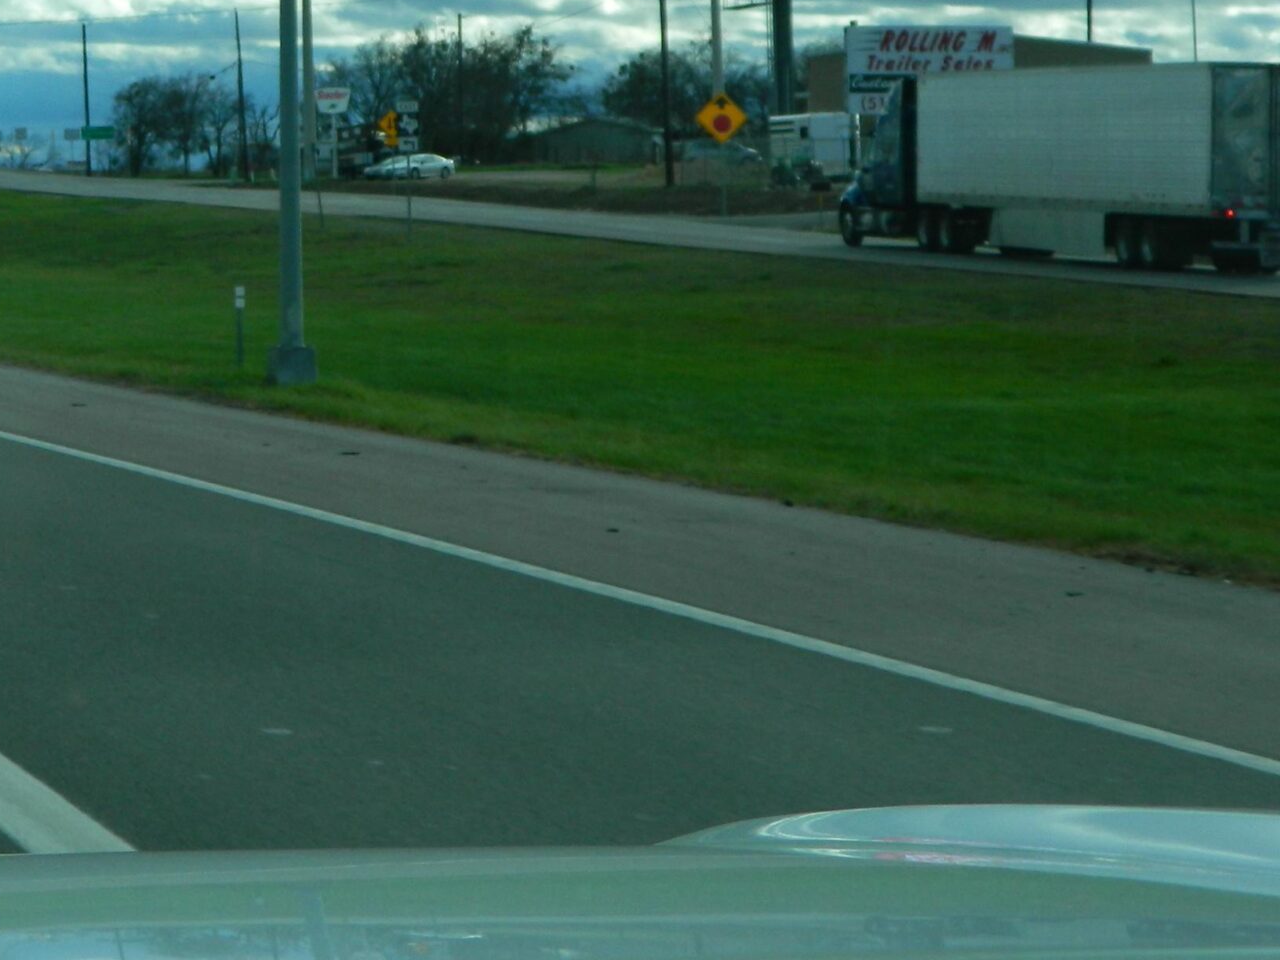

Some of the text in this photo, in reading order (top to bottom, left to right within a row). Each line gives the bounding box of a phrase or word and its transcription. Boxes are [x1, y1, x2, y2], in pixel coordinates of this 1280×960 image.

[880, 29, 968, 53] ROLLING
[976, 30, 997, 53] M
[867, 54, 995, 72] Trailer Sales
